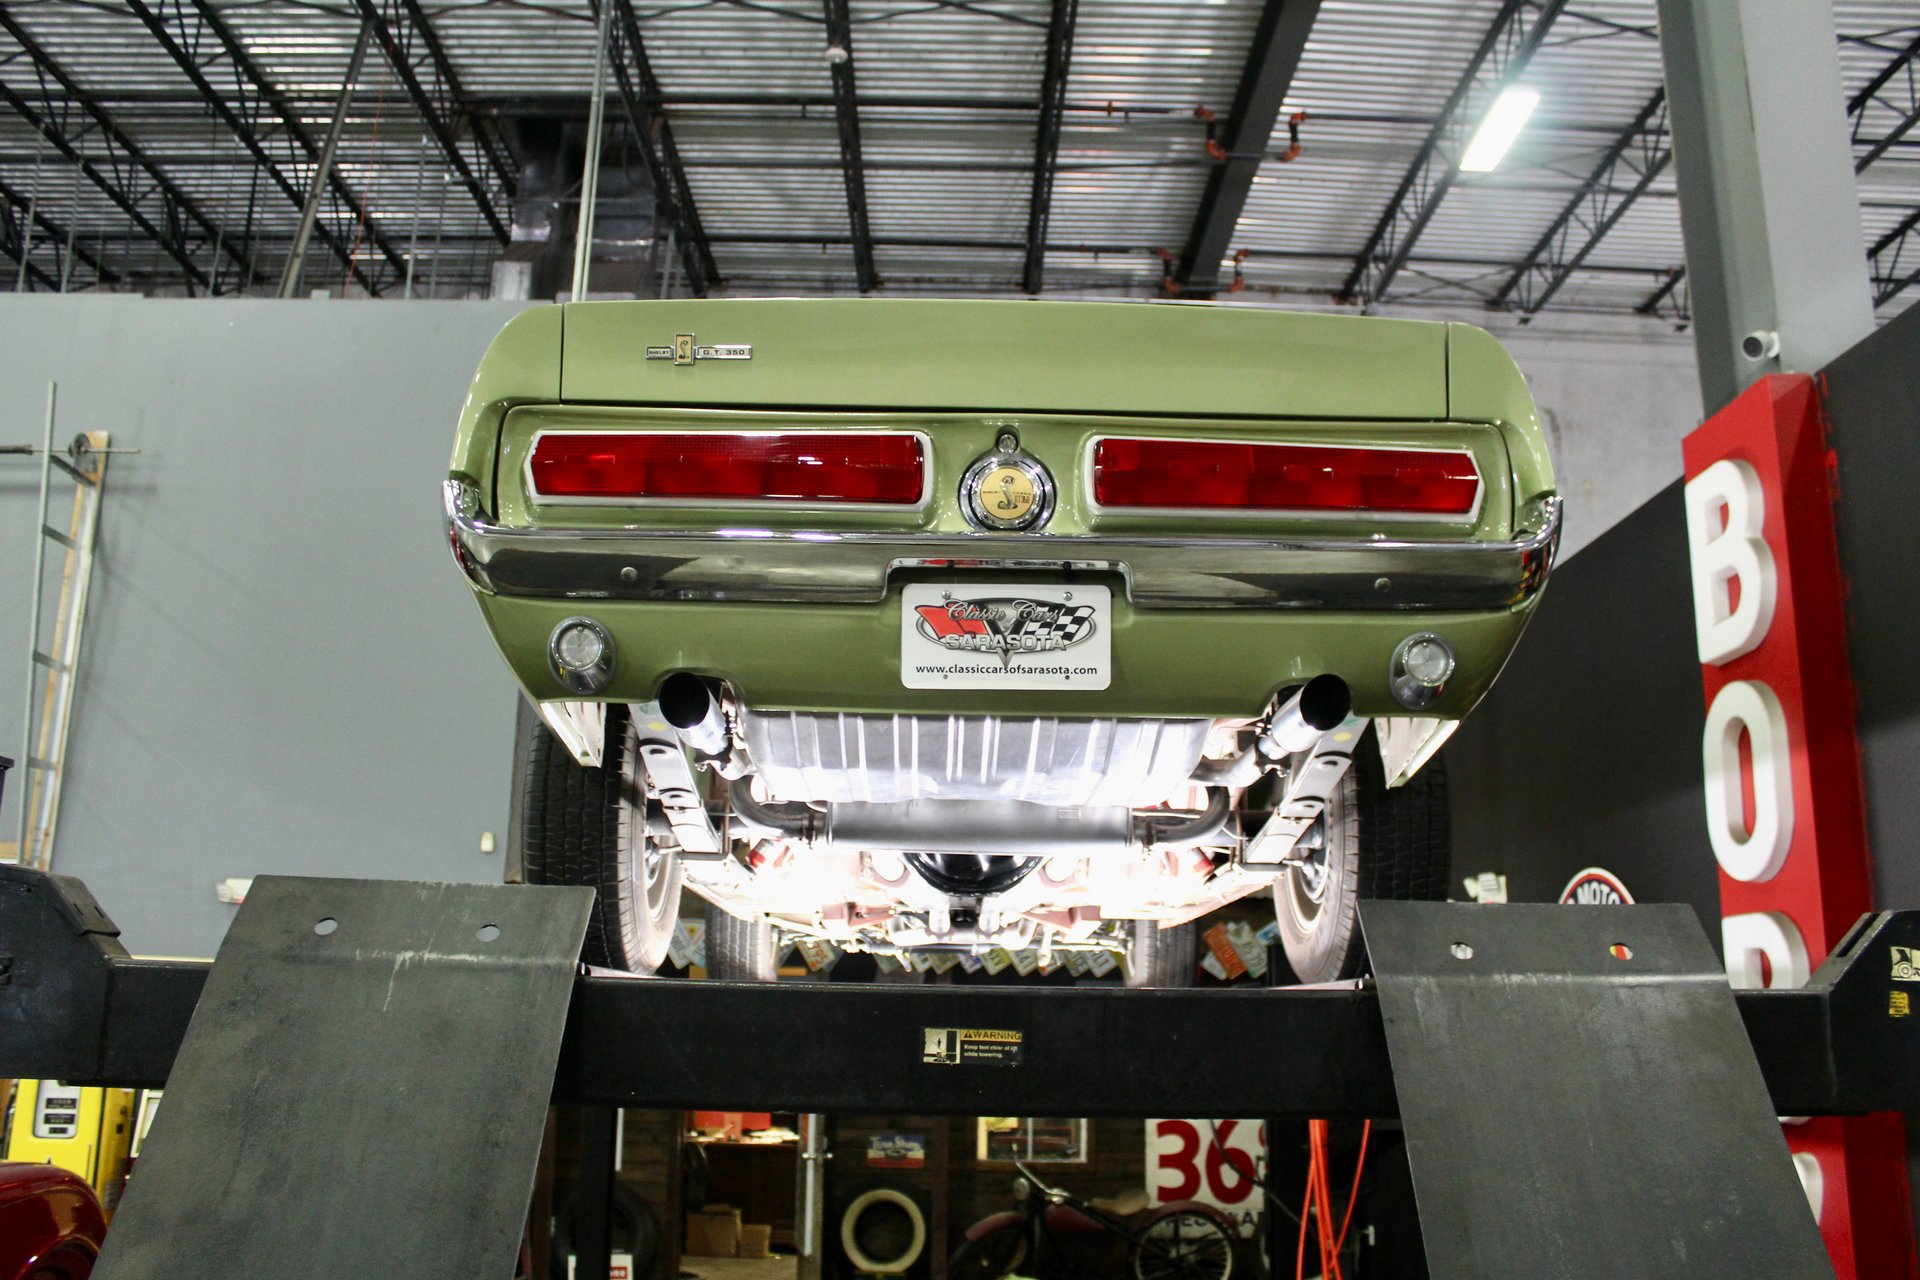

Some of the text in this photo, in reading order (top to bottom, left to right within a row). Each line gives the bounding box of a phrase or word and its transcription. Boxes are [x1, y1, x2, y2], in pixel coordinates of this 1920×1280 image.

[944, 599, 1060, 621] Classic Cars
[945, 633, 1067, 651] SARASOTA
[915, 664, 1098, 675] www.classiccarsofsarasota.com
[973, 1030, 1022, 1040] WARNING
[1156, 1119, 1256, 1205] 36
